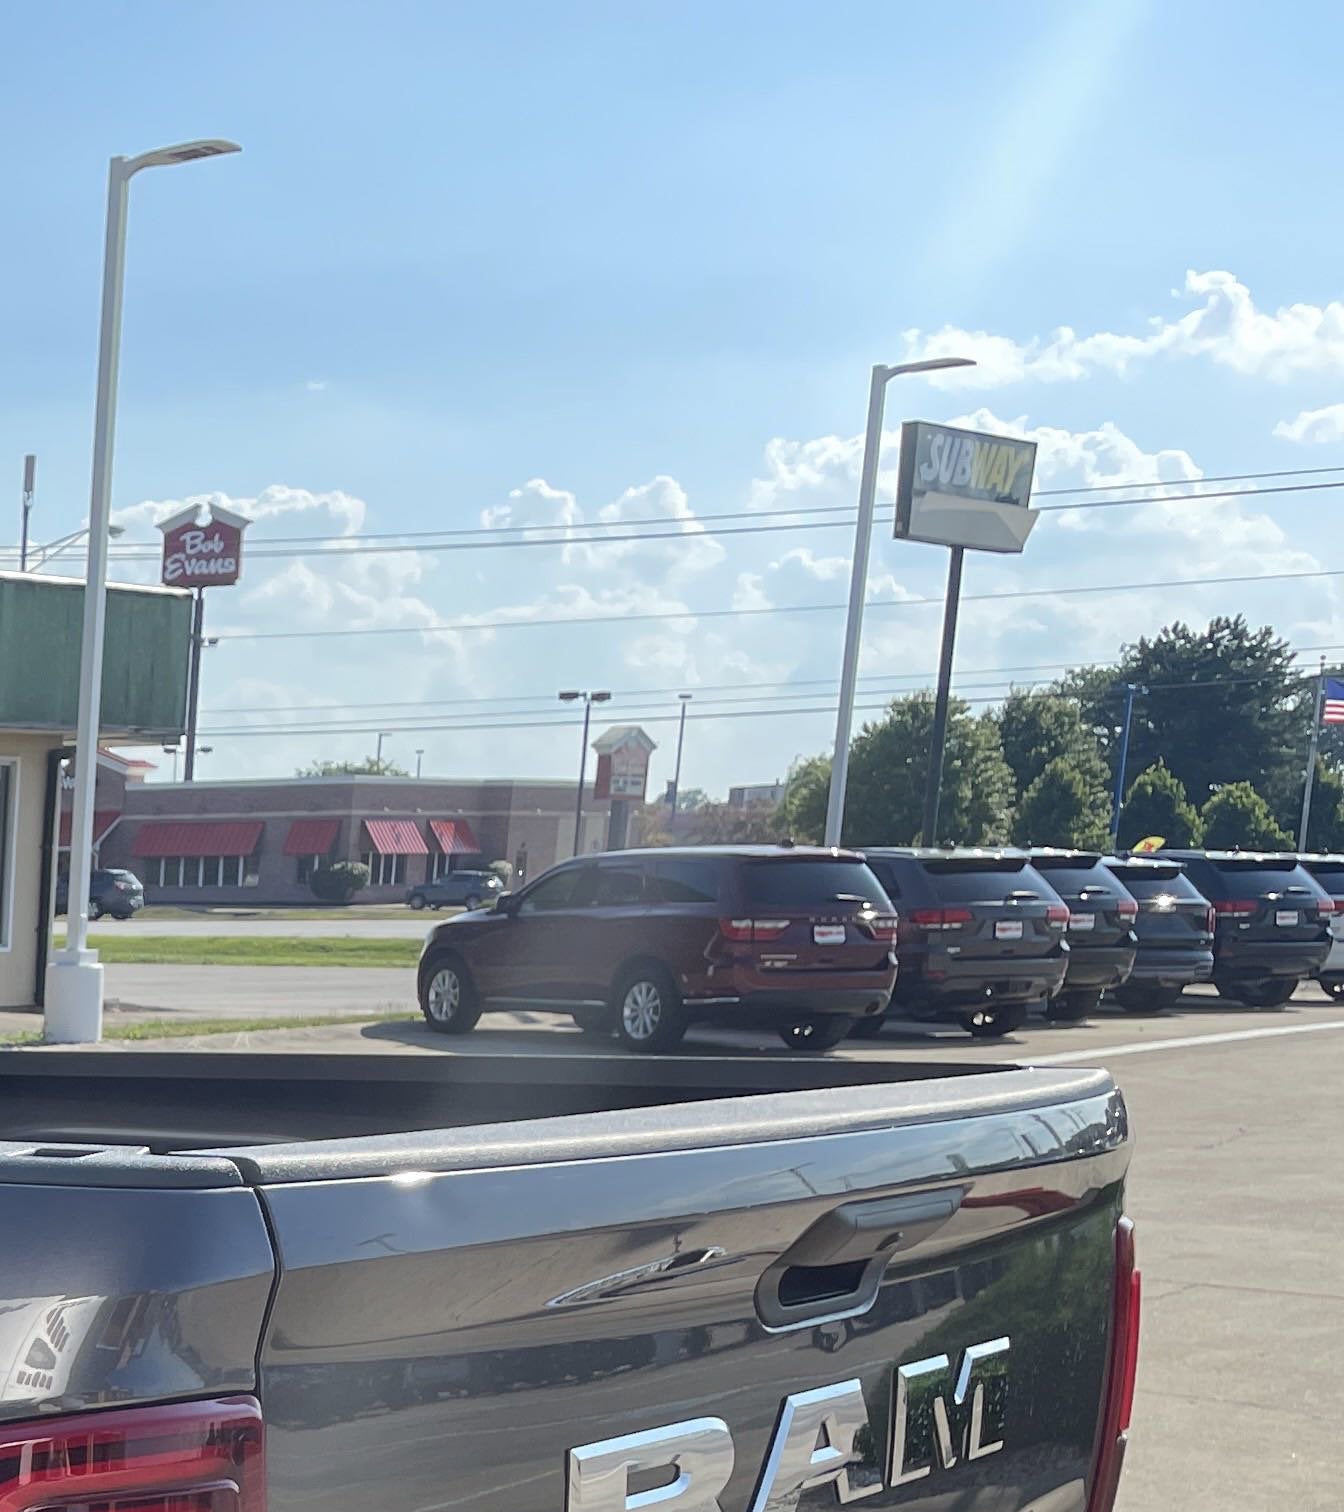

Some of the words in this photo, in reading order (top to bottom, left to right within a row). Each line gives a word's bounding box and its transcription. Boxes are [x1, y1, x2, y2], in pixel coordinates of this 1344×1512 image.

[920, 433, 1030, 494] SUBWAY
[179, 530, 224, 555] Bob
[164, 552, 236, 580] Evans
